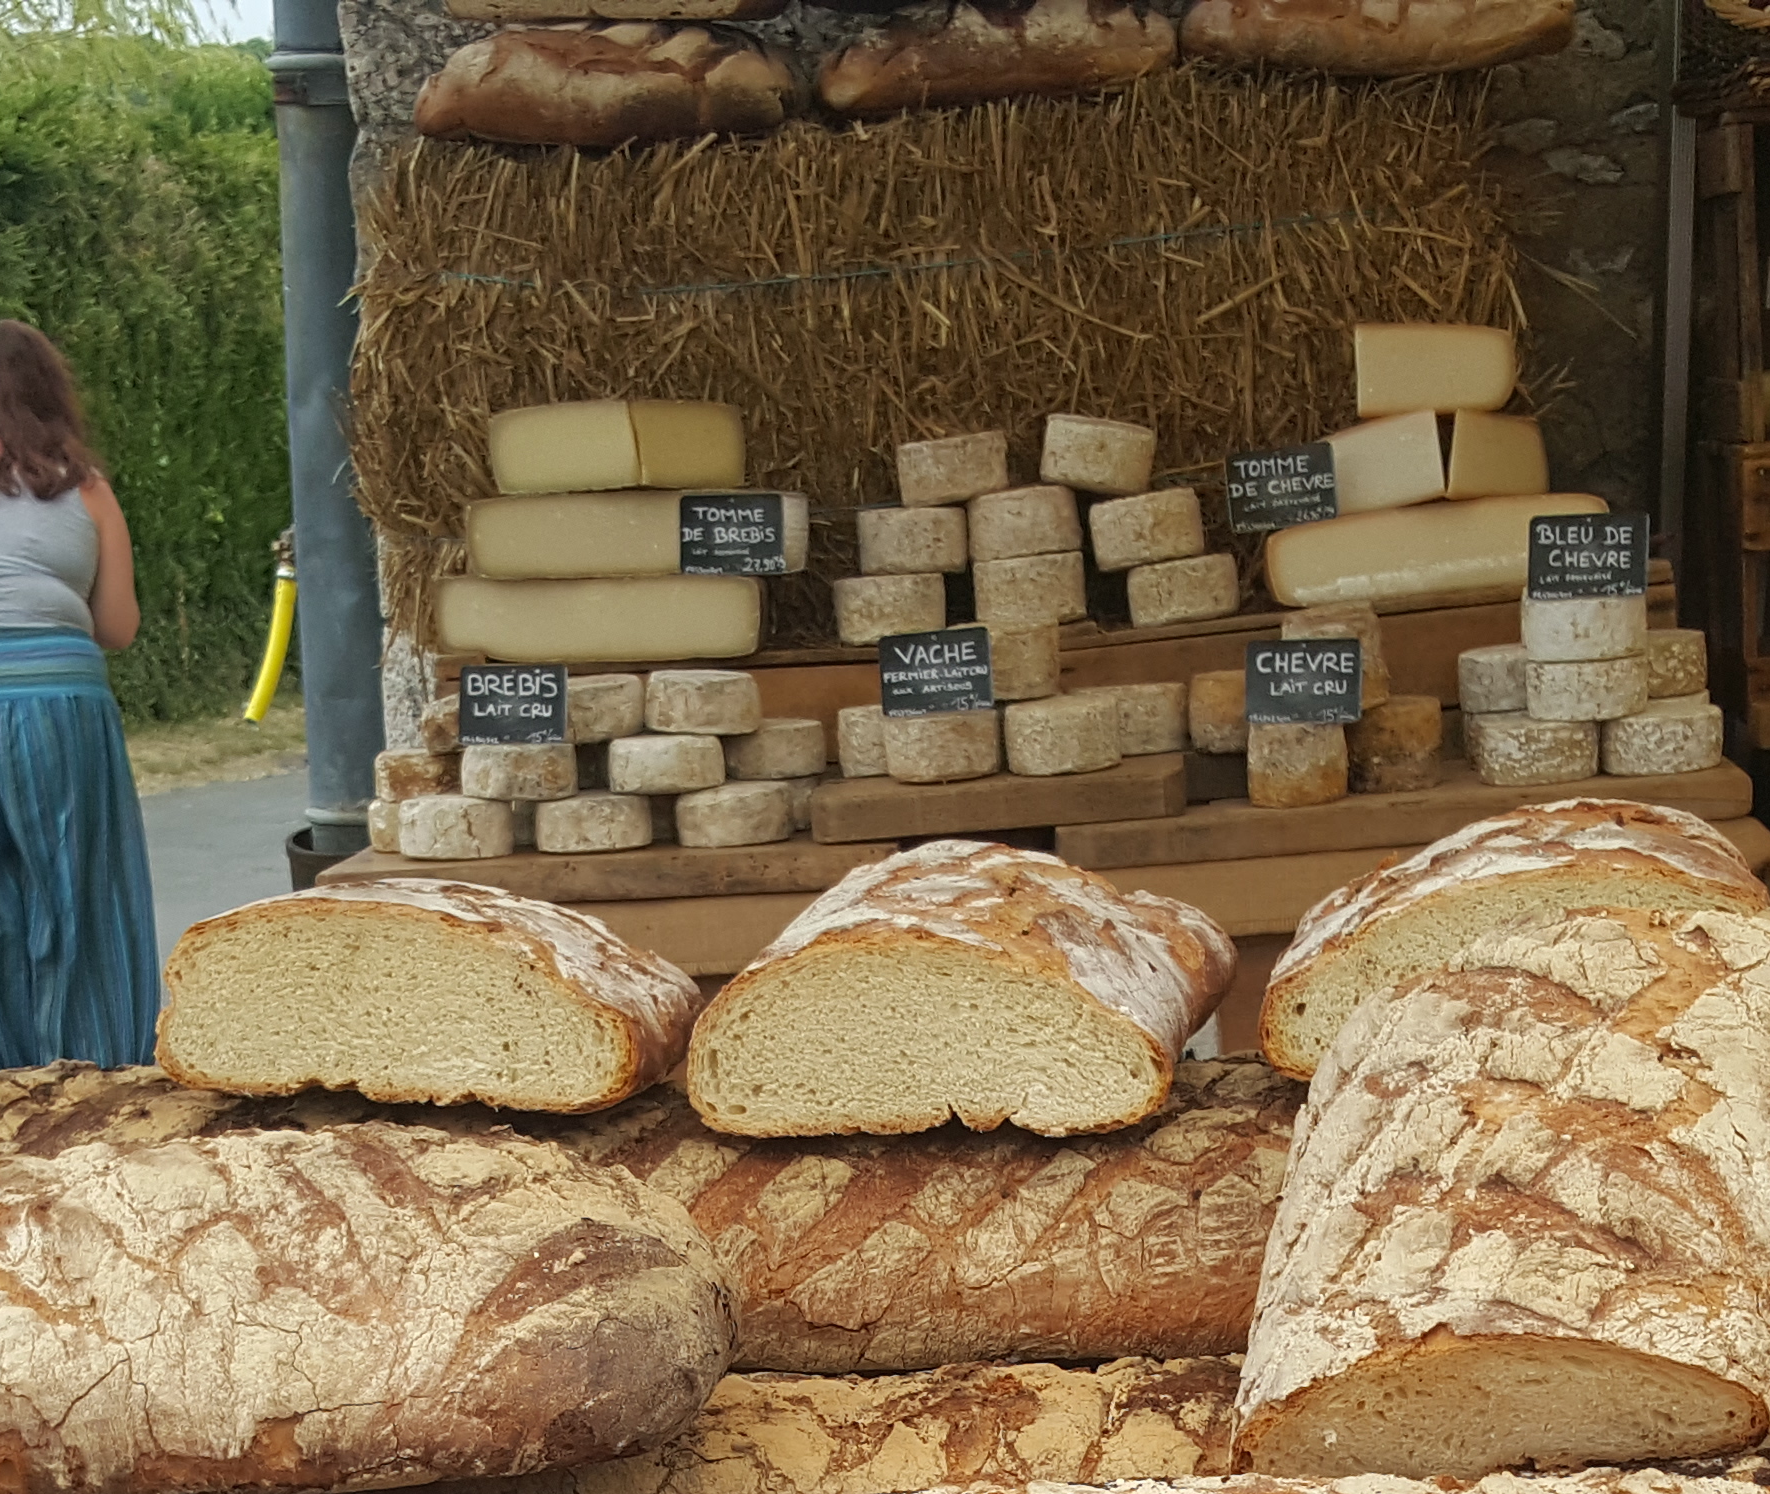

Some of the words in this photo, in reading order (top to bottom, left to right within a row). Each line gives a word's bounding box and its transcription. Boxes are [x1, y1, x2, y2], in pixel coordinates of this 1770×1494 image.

[1233, 455, 1310, 479] TOMME
[1229, 482, 1258, 497] DE
[692, 507, 765, 522] TOMME
[682, 527, 705, 542] DE
[1536, 524, 1593, 545] BLEU
[1604, 526, 1633, 545] DE
[1549, 549, 1632, 569] CHEVRE
[893, 641, 977, 666] VACHE
[1256, 651, 1355, 674] CHEVRE
[1313, 679, 1347, 695] CRU
[519, 703, 552, 718] CRU
